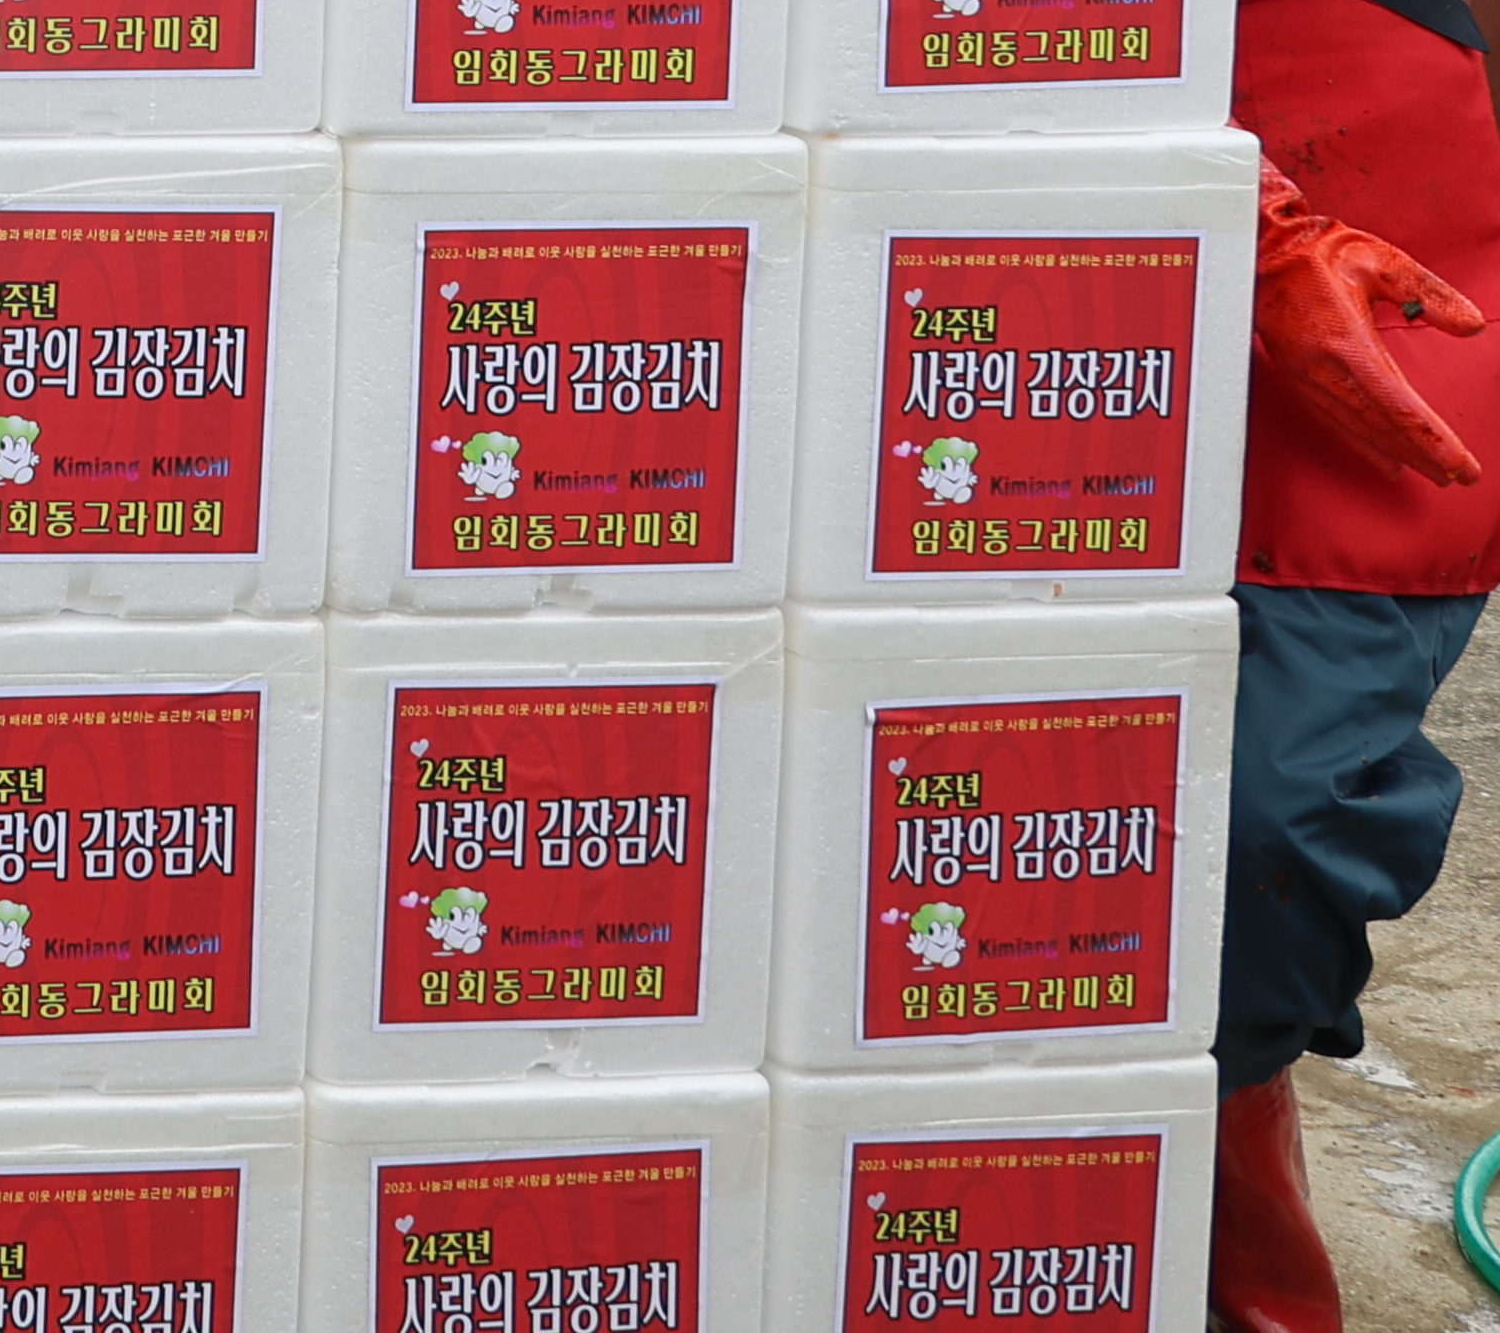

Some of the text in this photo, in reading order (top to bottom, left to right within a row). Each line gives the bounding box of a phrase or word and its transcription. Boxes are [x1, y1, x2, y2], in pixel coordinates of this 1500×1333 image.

[452, 48, 695, 86] 임회동그라미회
[922, 26, 1150, 69] 임회동그라미회
[912, 307, 996, 341] 24주년
[90, 326, 246, 399] 김장김치
[902, 348, 1172, 421] 사랑의 김장김치
[150, 456, 230, 479] KIMCHI
[912, 517, 1148, 556] 임회동그라미회
[418, 757, 505, 792] 24주년
[409, 795, 687, 871] 사랑의 김장김치
[420, 965, 664, 1006] 임회동그라미회
[875, 1208, 958, 1244] 24주년
[865, 1243, 1133, 1320] 사랑의 김장김치
